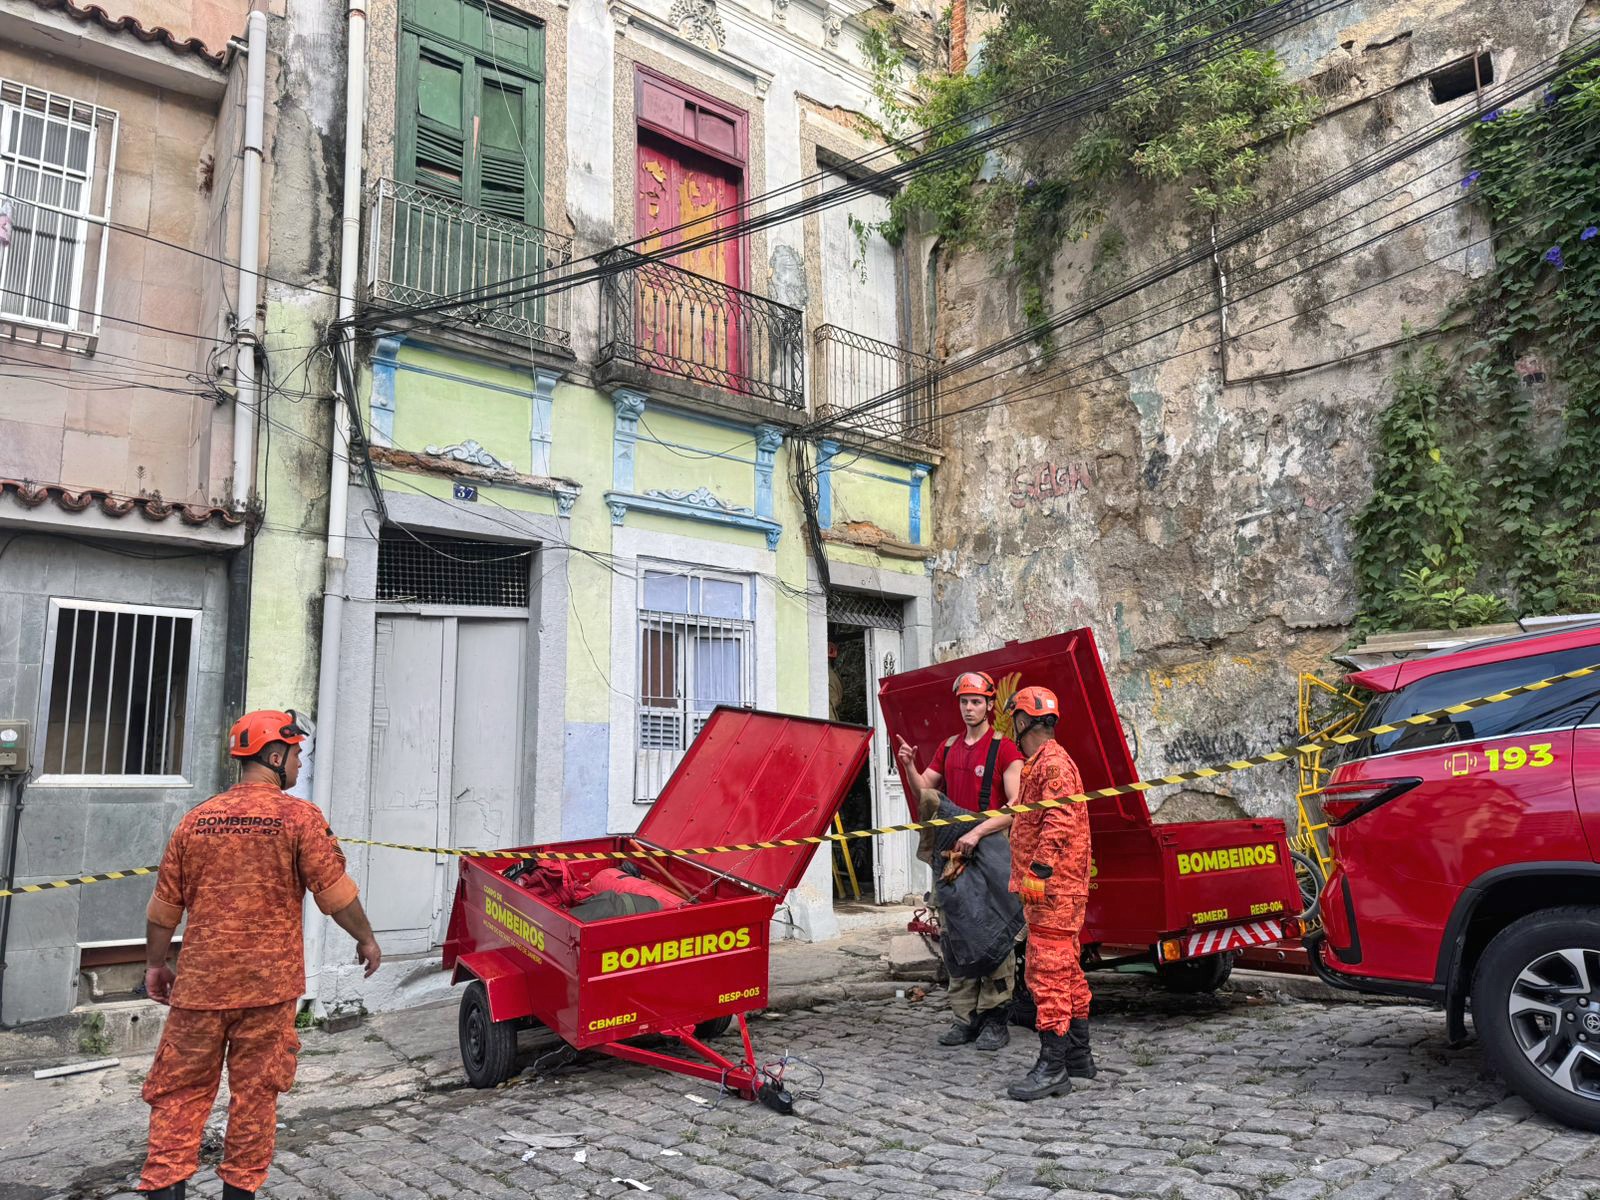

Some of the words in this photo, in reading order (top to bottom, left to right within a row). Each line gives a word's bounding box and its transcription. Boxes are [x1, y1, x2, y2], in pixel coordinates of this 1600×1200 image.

[457, 485, 474, 499] 37
[1484, 742, 1554, 772] 193
[197, 816, 282, 827] BOMBEIROS
[1177, 844, 1276, 875] BOMBEIROS
[485, 896, 545, 952] BOMBEIROS
[601, 927, 751, 973] BOMBEIROS
[718, 986, 760, 1004] RESP-003
[588, 1012, 637, 1031] CBMERJ
